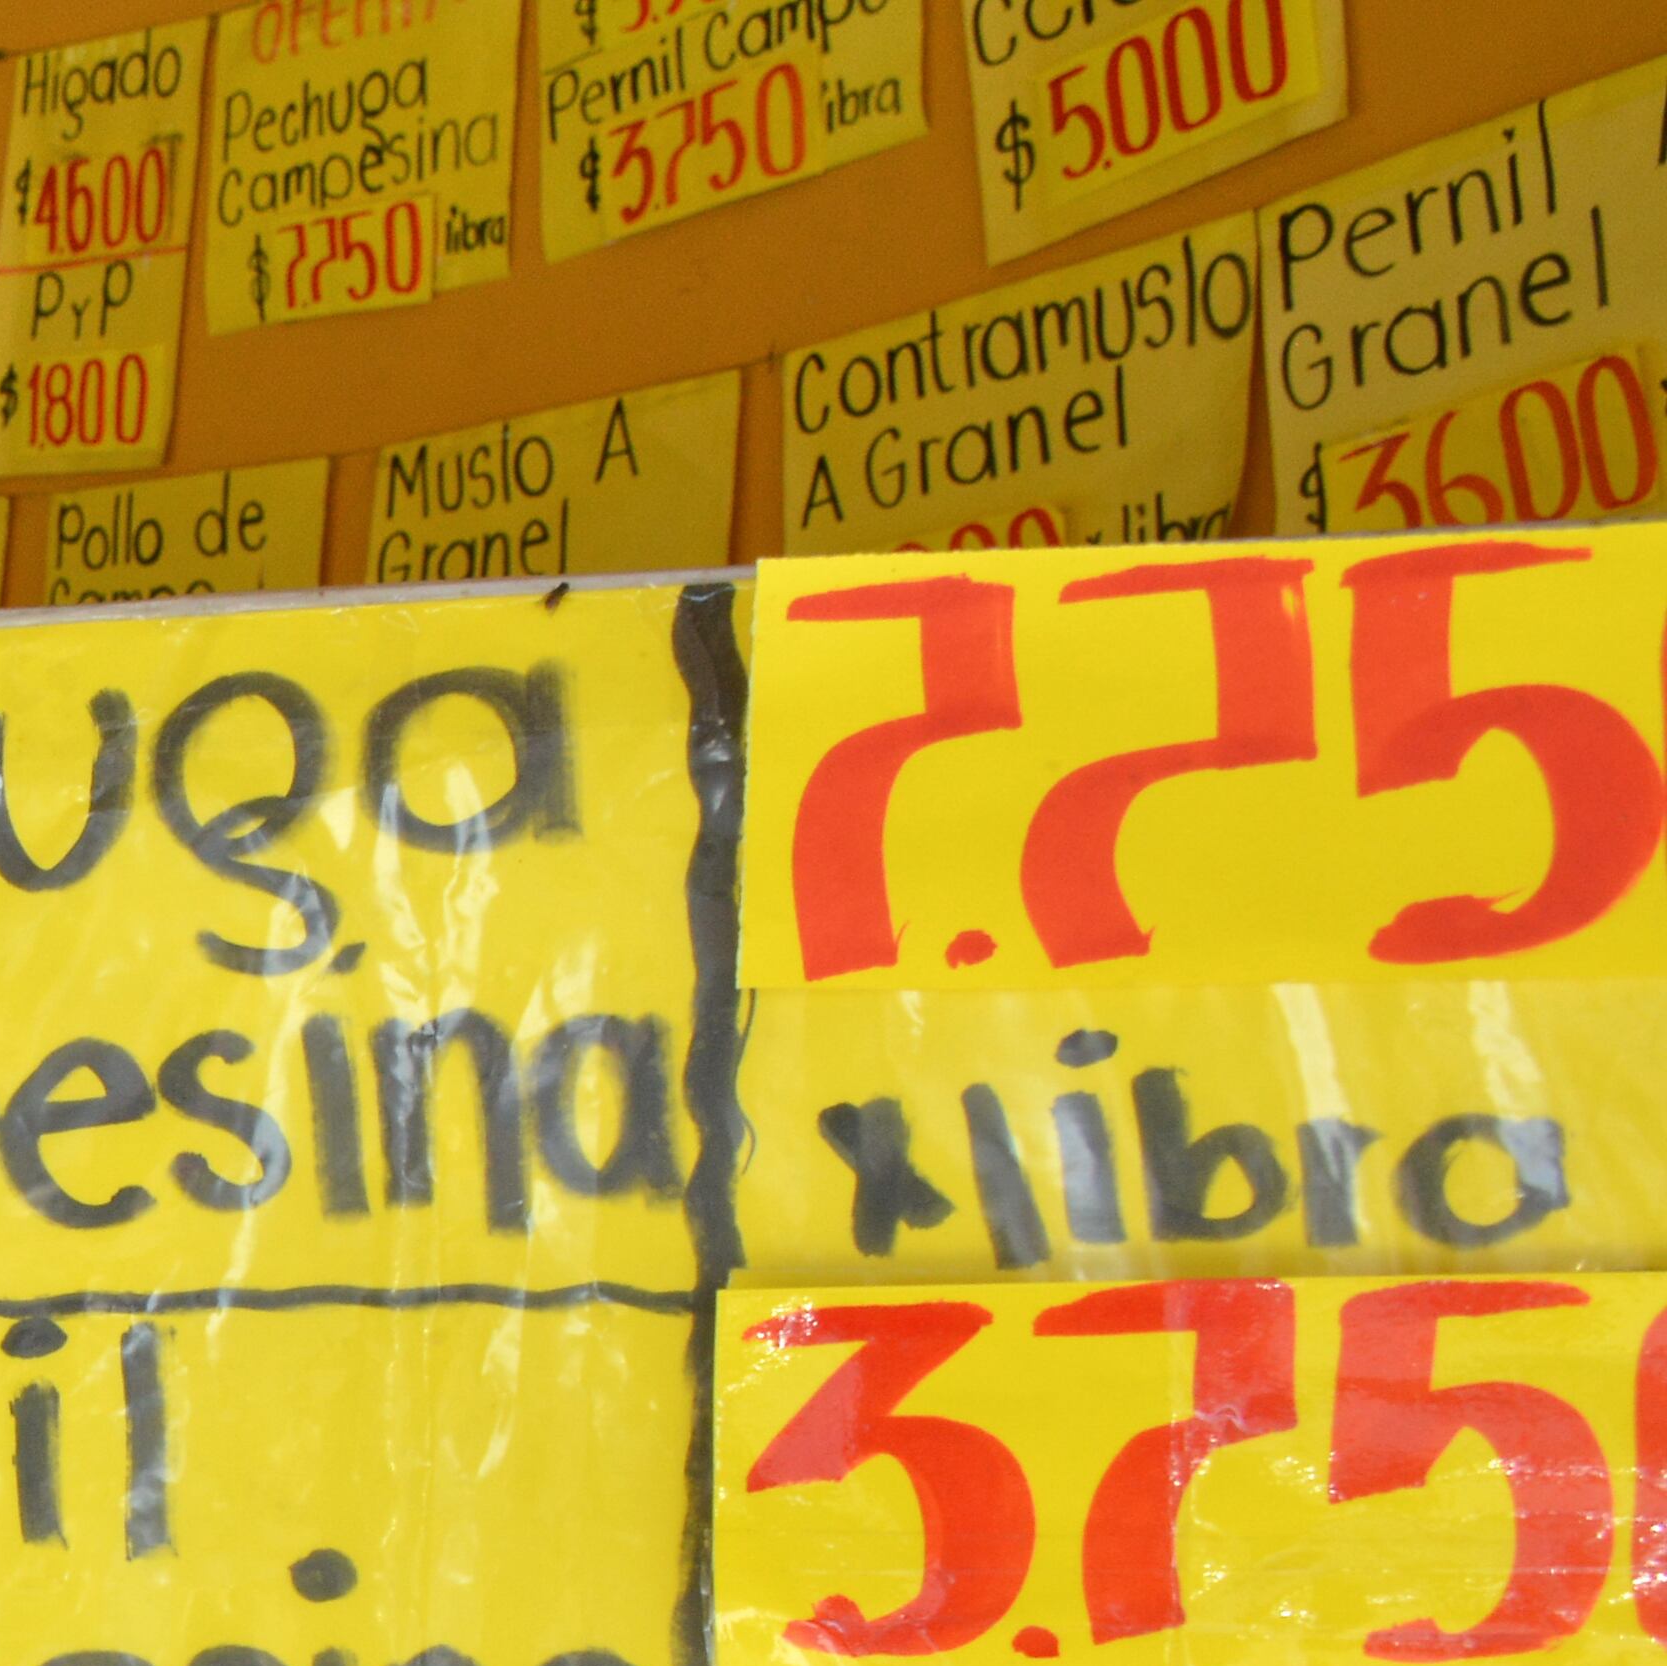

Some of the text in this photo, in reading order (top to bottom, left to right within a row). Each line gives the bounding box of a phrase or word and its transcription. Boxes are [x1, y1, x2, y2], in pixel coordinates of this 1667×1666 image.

[223, 56, 429, 163] Pechuga
[548, 27, 685, 143] Pernil
[218, 112, 499, 228] Campesina
[1276, 97, 1557, 313] Pernil
[794, 234, 1252, 435] Contramuslo
[1280, 204, 1611, 412] Granel
[386, 397, 639, 519] Muslo A
[801, 364, 1129, 529] A Granel
[55, 470, 267, 571] Pollo de
[377, 498, 569, 584] Granel
[785, 540, 1667, 982] 7.75
[741, 1277, 1667, 1662] 3.75
